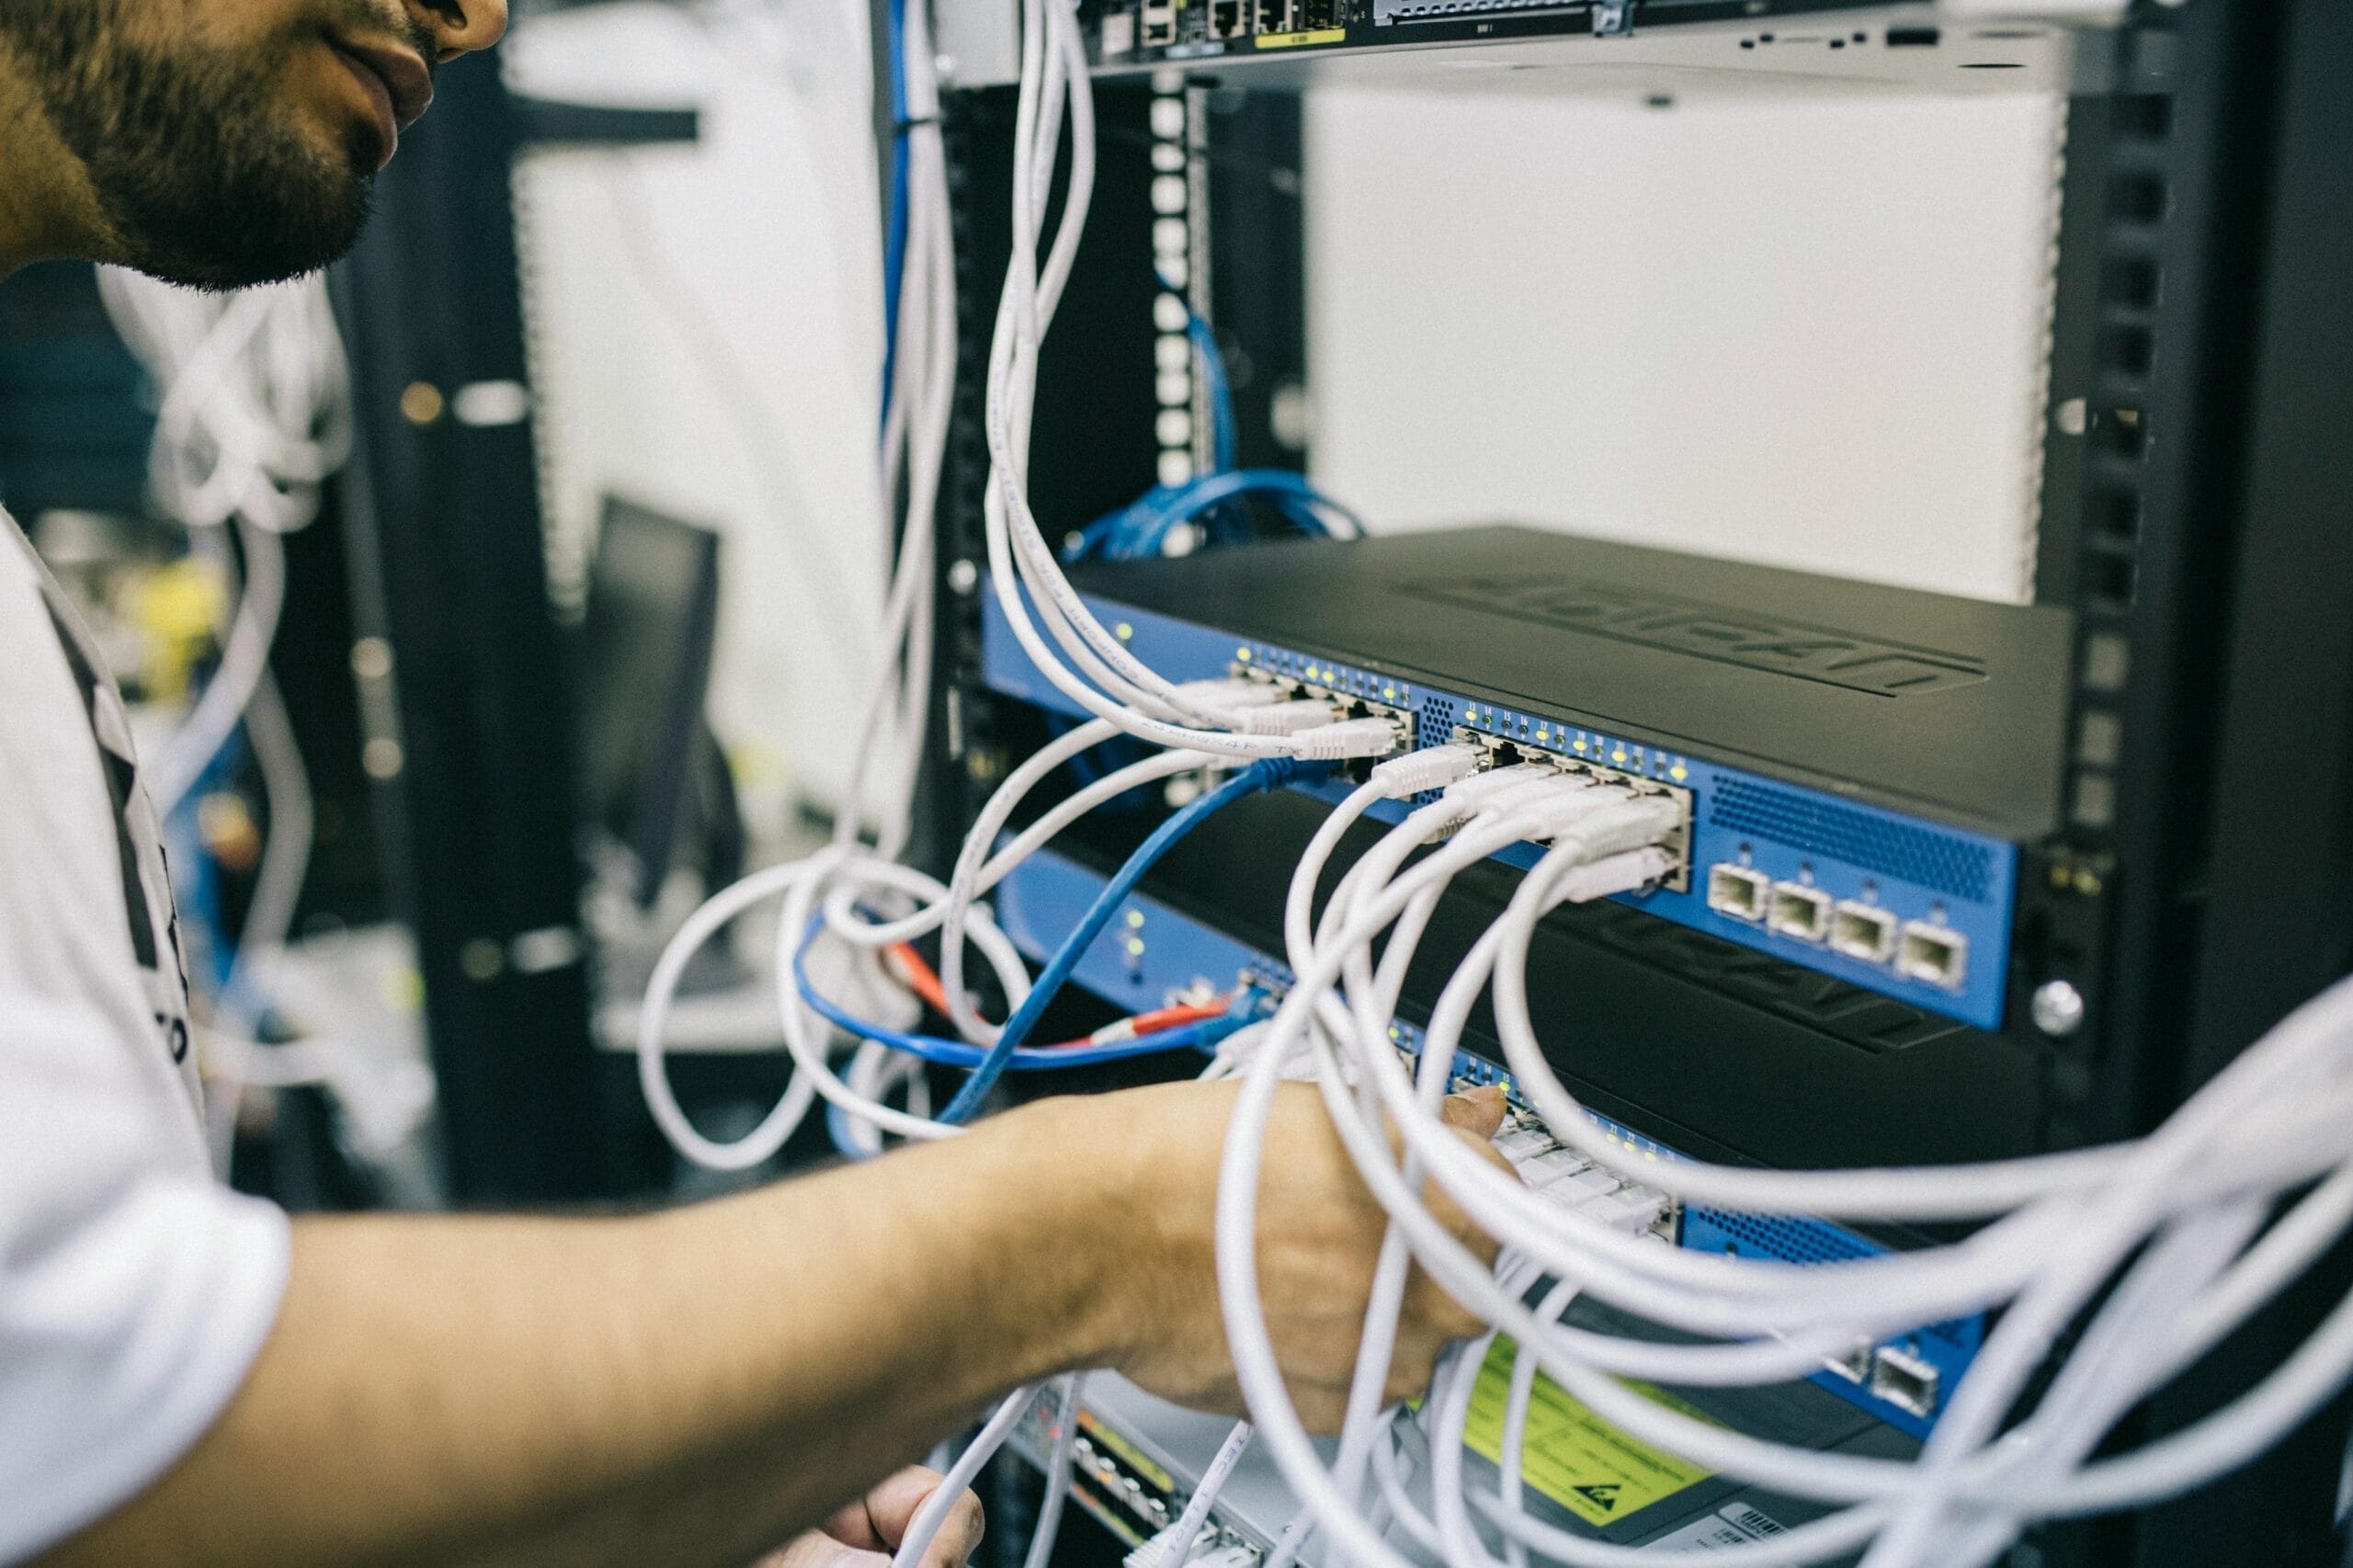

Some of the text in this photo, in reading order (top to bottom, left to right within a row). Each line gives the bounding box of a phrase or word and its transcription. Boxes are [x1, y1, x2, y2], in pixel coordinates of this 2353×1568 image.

[1484, 705, 1493, 717] 14
[1503, 710, 1512, 722] 15
[1520, 714, 1529, 726] 16
[1540, 720, 1549, 731] 17
